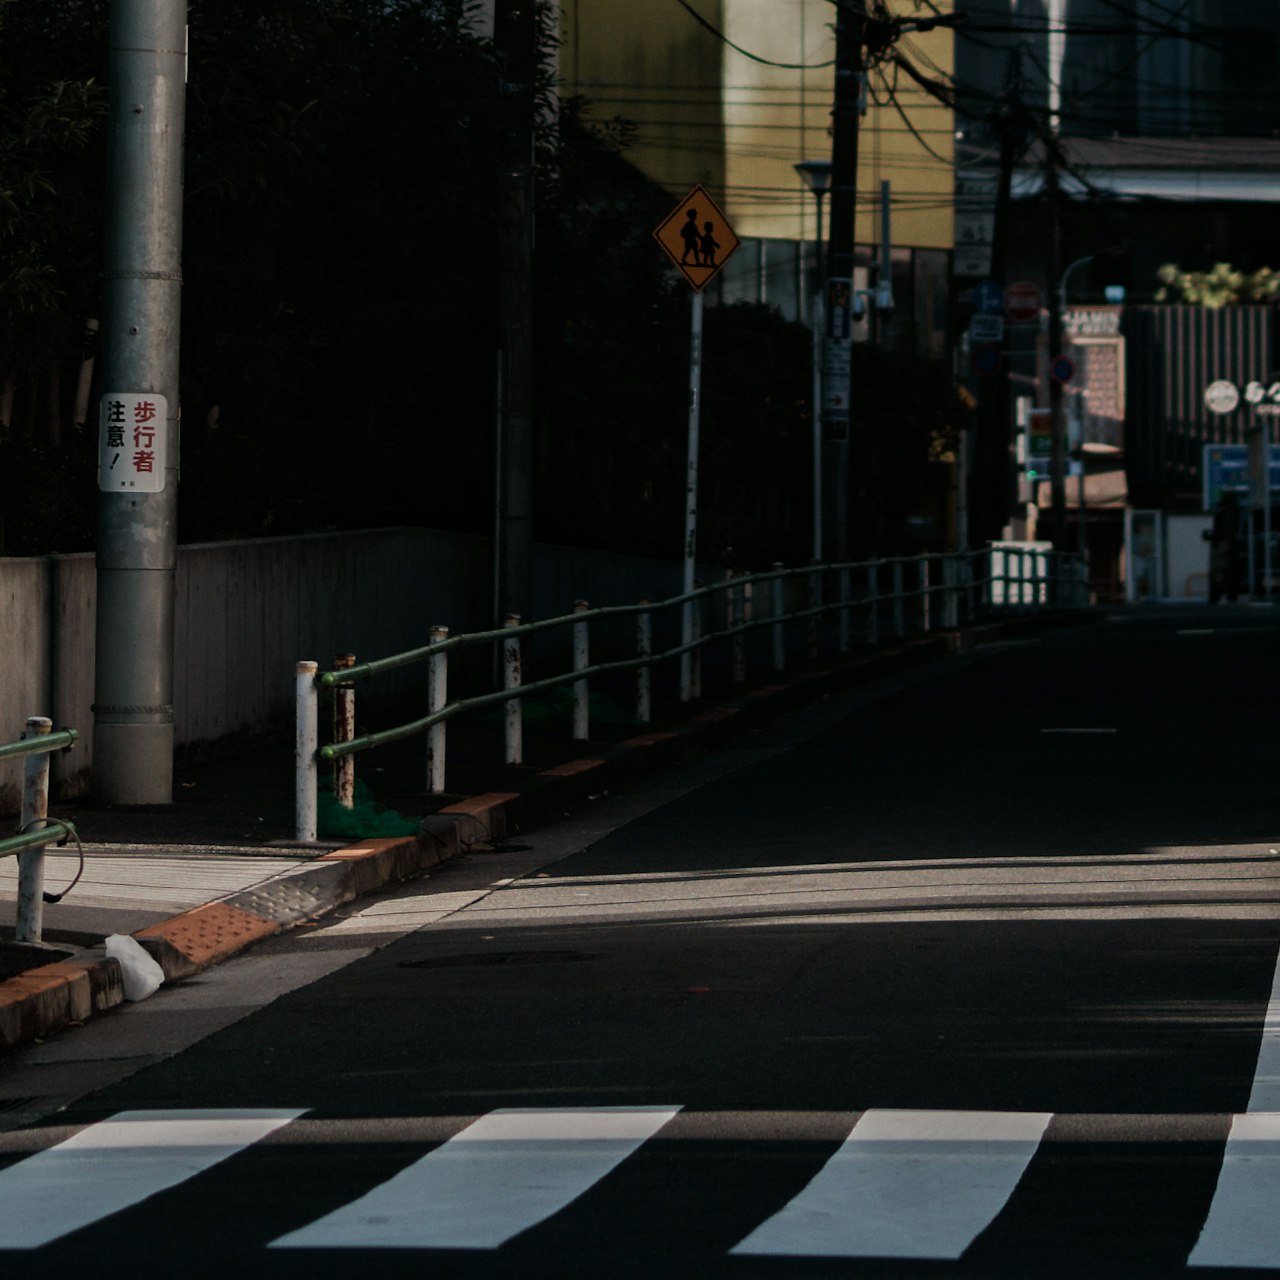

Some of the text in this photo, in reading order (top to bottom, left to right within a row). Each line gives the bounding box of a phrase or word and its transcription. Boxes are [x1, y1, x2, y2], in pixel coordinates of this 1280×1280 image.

[106, 400, 126, 471] 注意!
[132, 401, 157, 473] 歩行者
